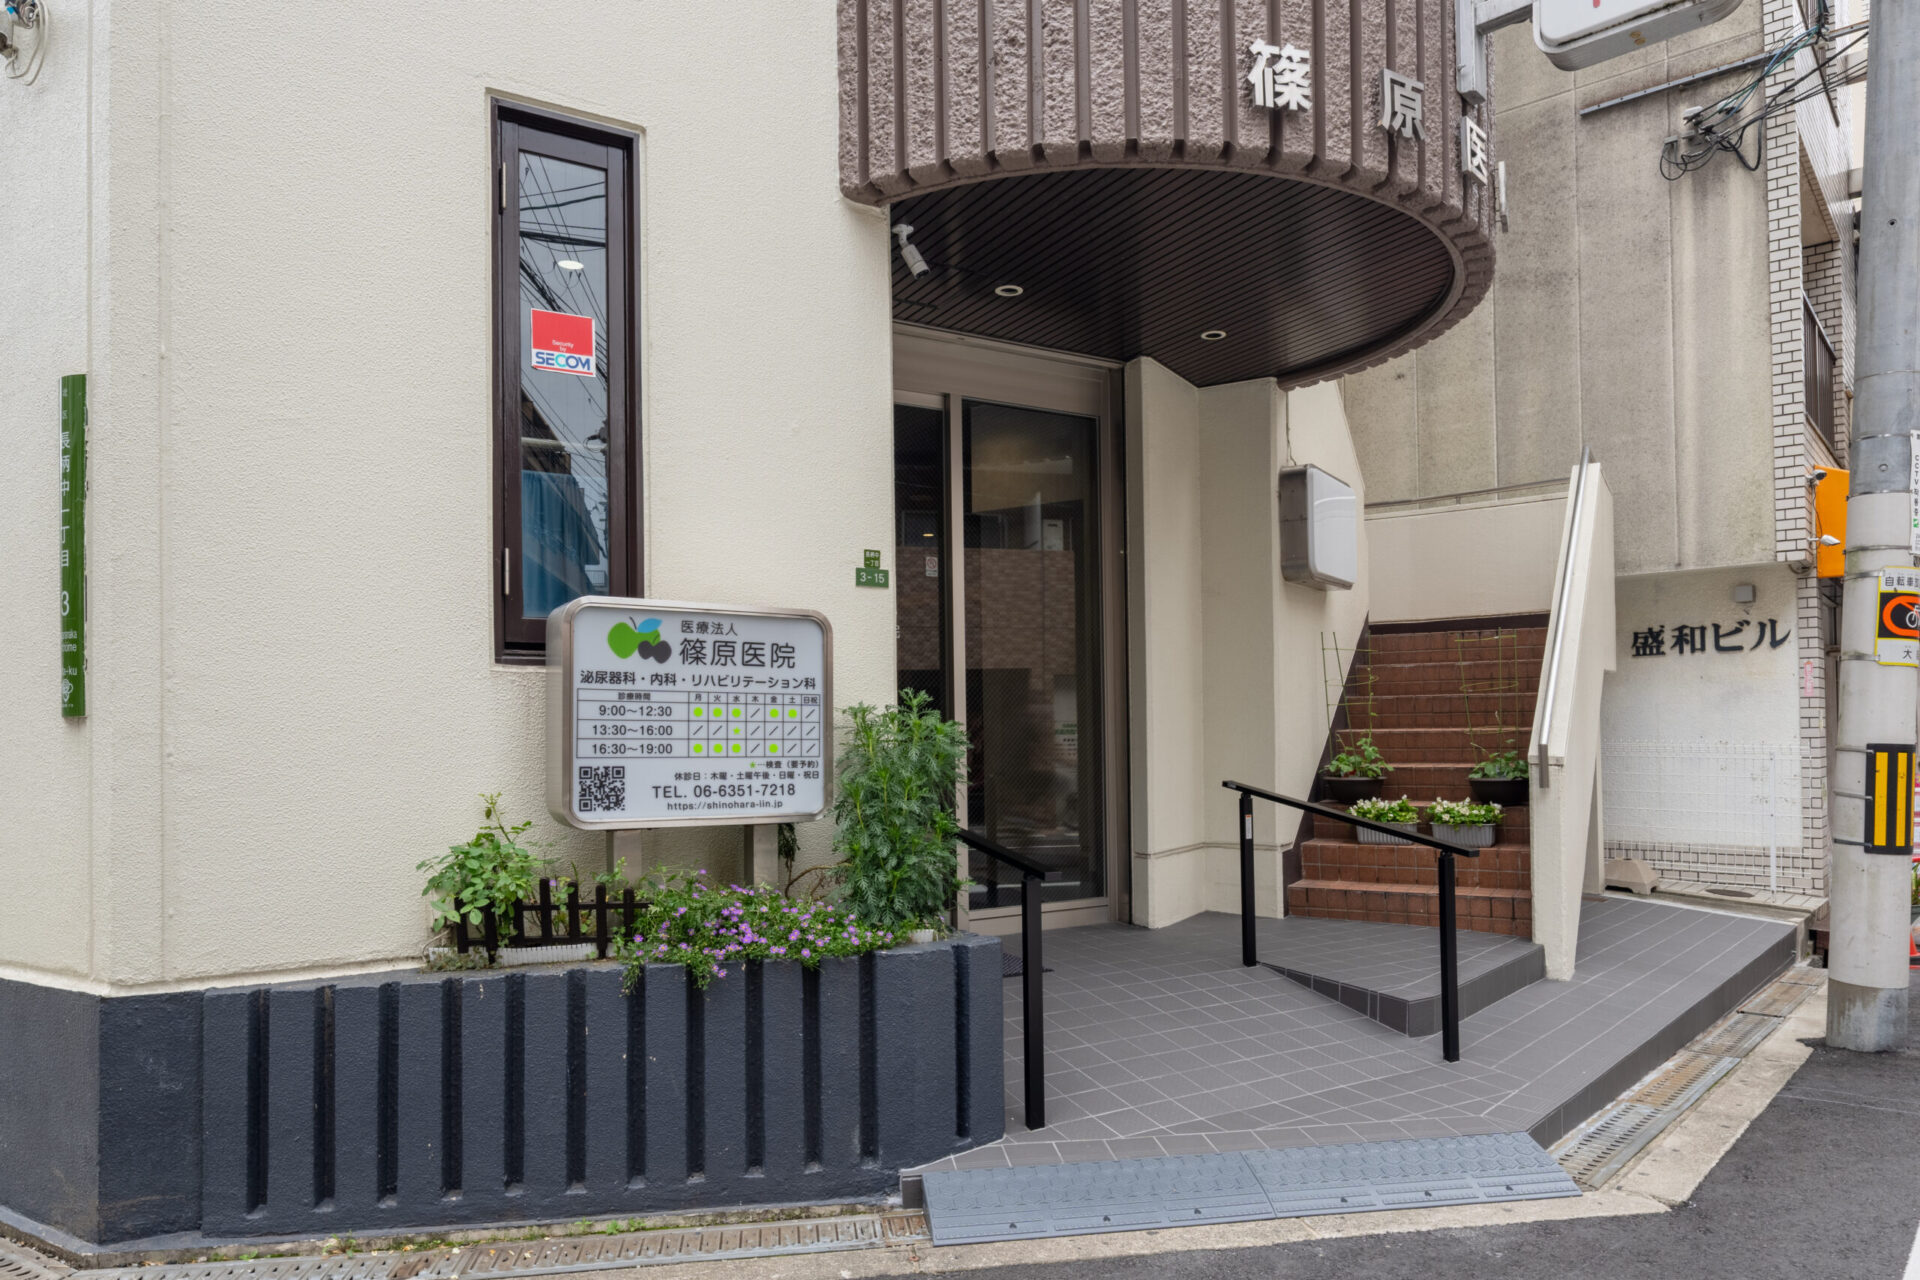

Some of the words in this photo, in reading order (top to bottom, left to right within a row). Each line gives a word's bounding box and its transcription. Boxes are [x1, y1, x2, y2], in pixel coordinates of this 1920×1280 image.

[552, 339, 574, 349] Security
[536, 351, 590, 371] SECOM
[859, 571, 885, 584] 3-15
[681, 620, 738, 636] 医療法人
[1631, 618, 1792, 657] 盛和ビル
[679, 637, 796, 669] 篠原医院
[617, 692, 651, 701] 診療時間
[694, 693, 702, 702] 月
[713, 694, 722, 703] 火
[732, 694, 741, 703] 水
[751, 695, 760, 703] 木
[770, 695, 778, 704] 金
[788, 695, 796, 704] 土
[803, 695, 818, 704] 日祝
[652, 785, 687, 799] TEL.
[693, 783, 796, 798] 06-6351-7218
[667, 800, 783, 811] https://shinohara-iin.jp
